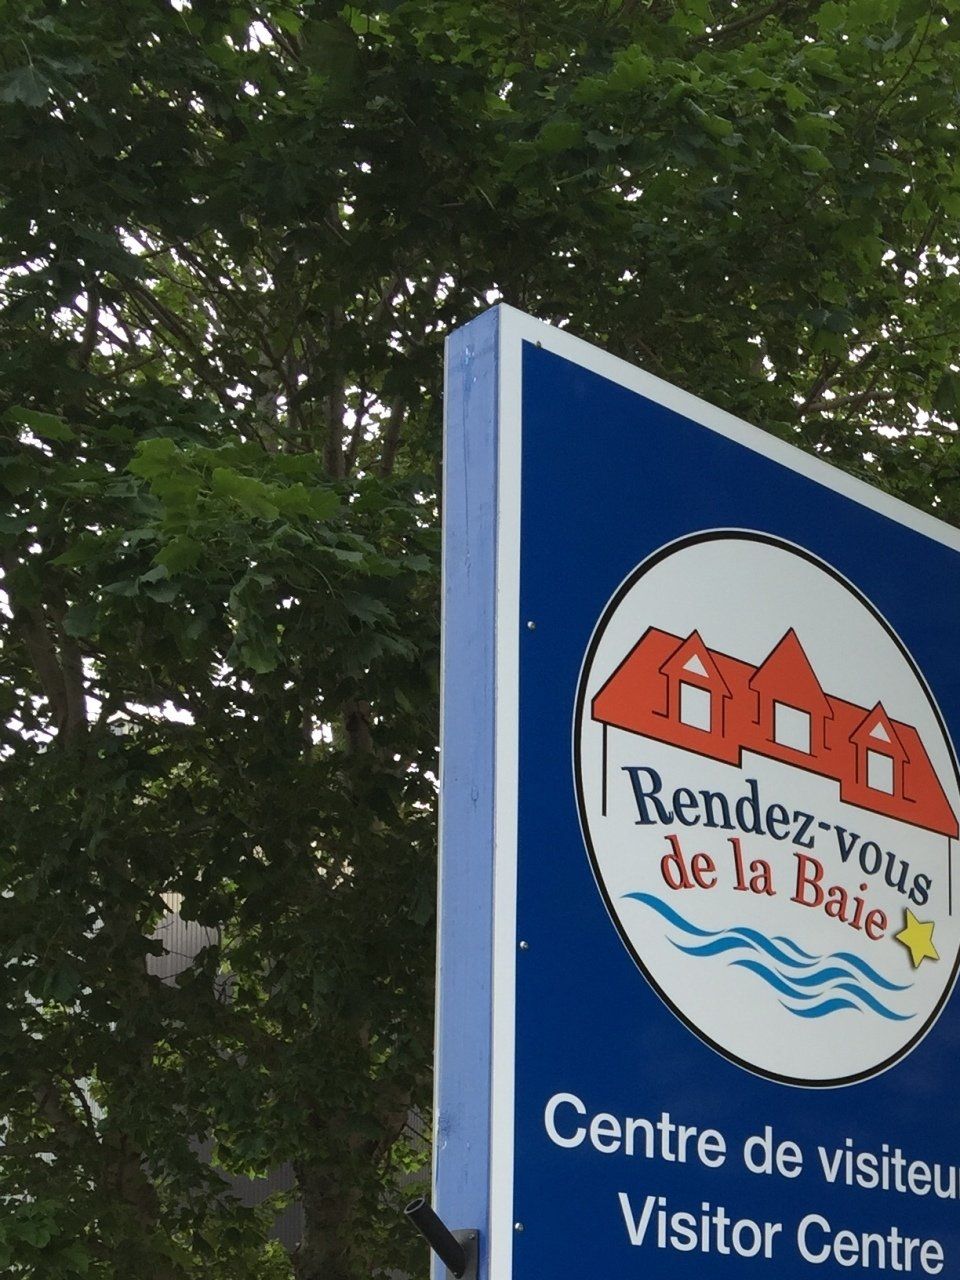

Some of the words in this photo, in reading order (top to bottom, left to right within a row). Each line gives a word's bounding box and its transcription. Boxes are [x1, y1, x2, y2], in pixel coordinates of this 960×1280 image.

[621, 766, 932, 906] Rendez-vous
[660, 834, 717, 891] de
[727, 837, 777, 897] la
[789, 851, 889, 941] Baie
[544, 1092, 727, 1168] Centre
[743, 1125, 804, 1179] de
[618, 1191, 783, 1259] Visitor
[797, 1213, 945, 1275] Centre
